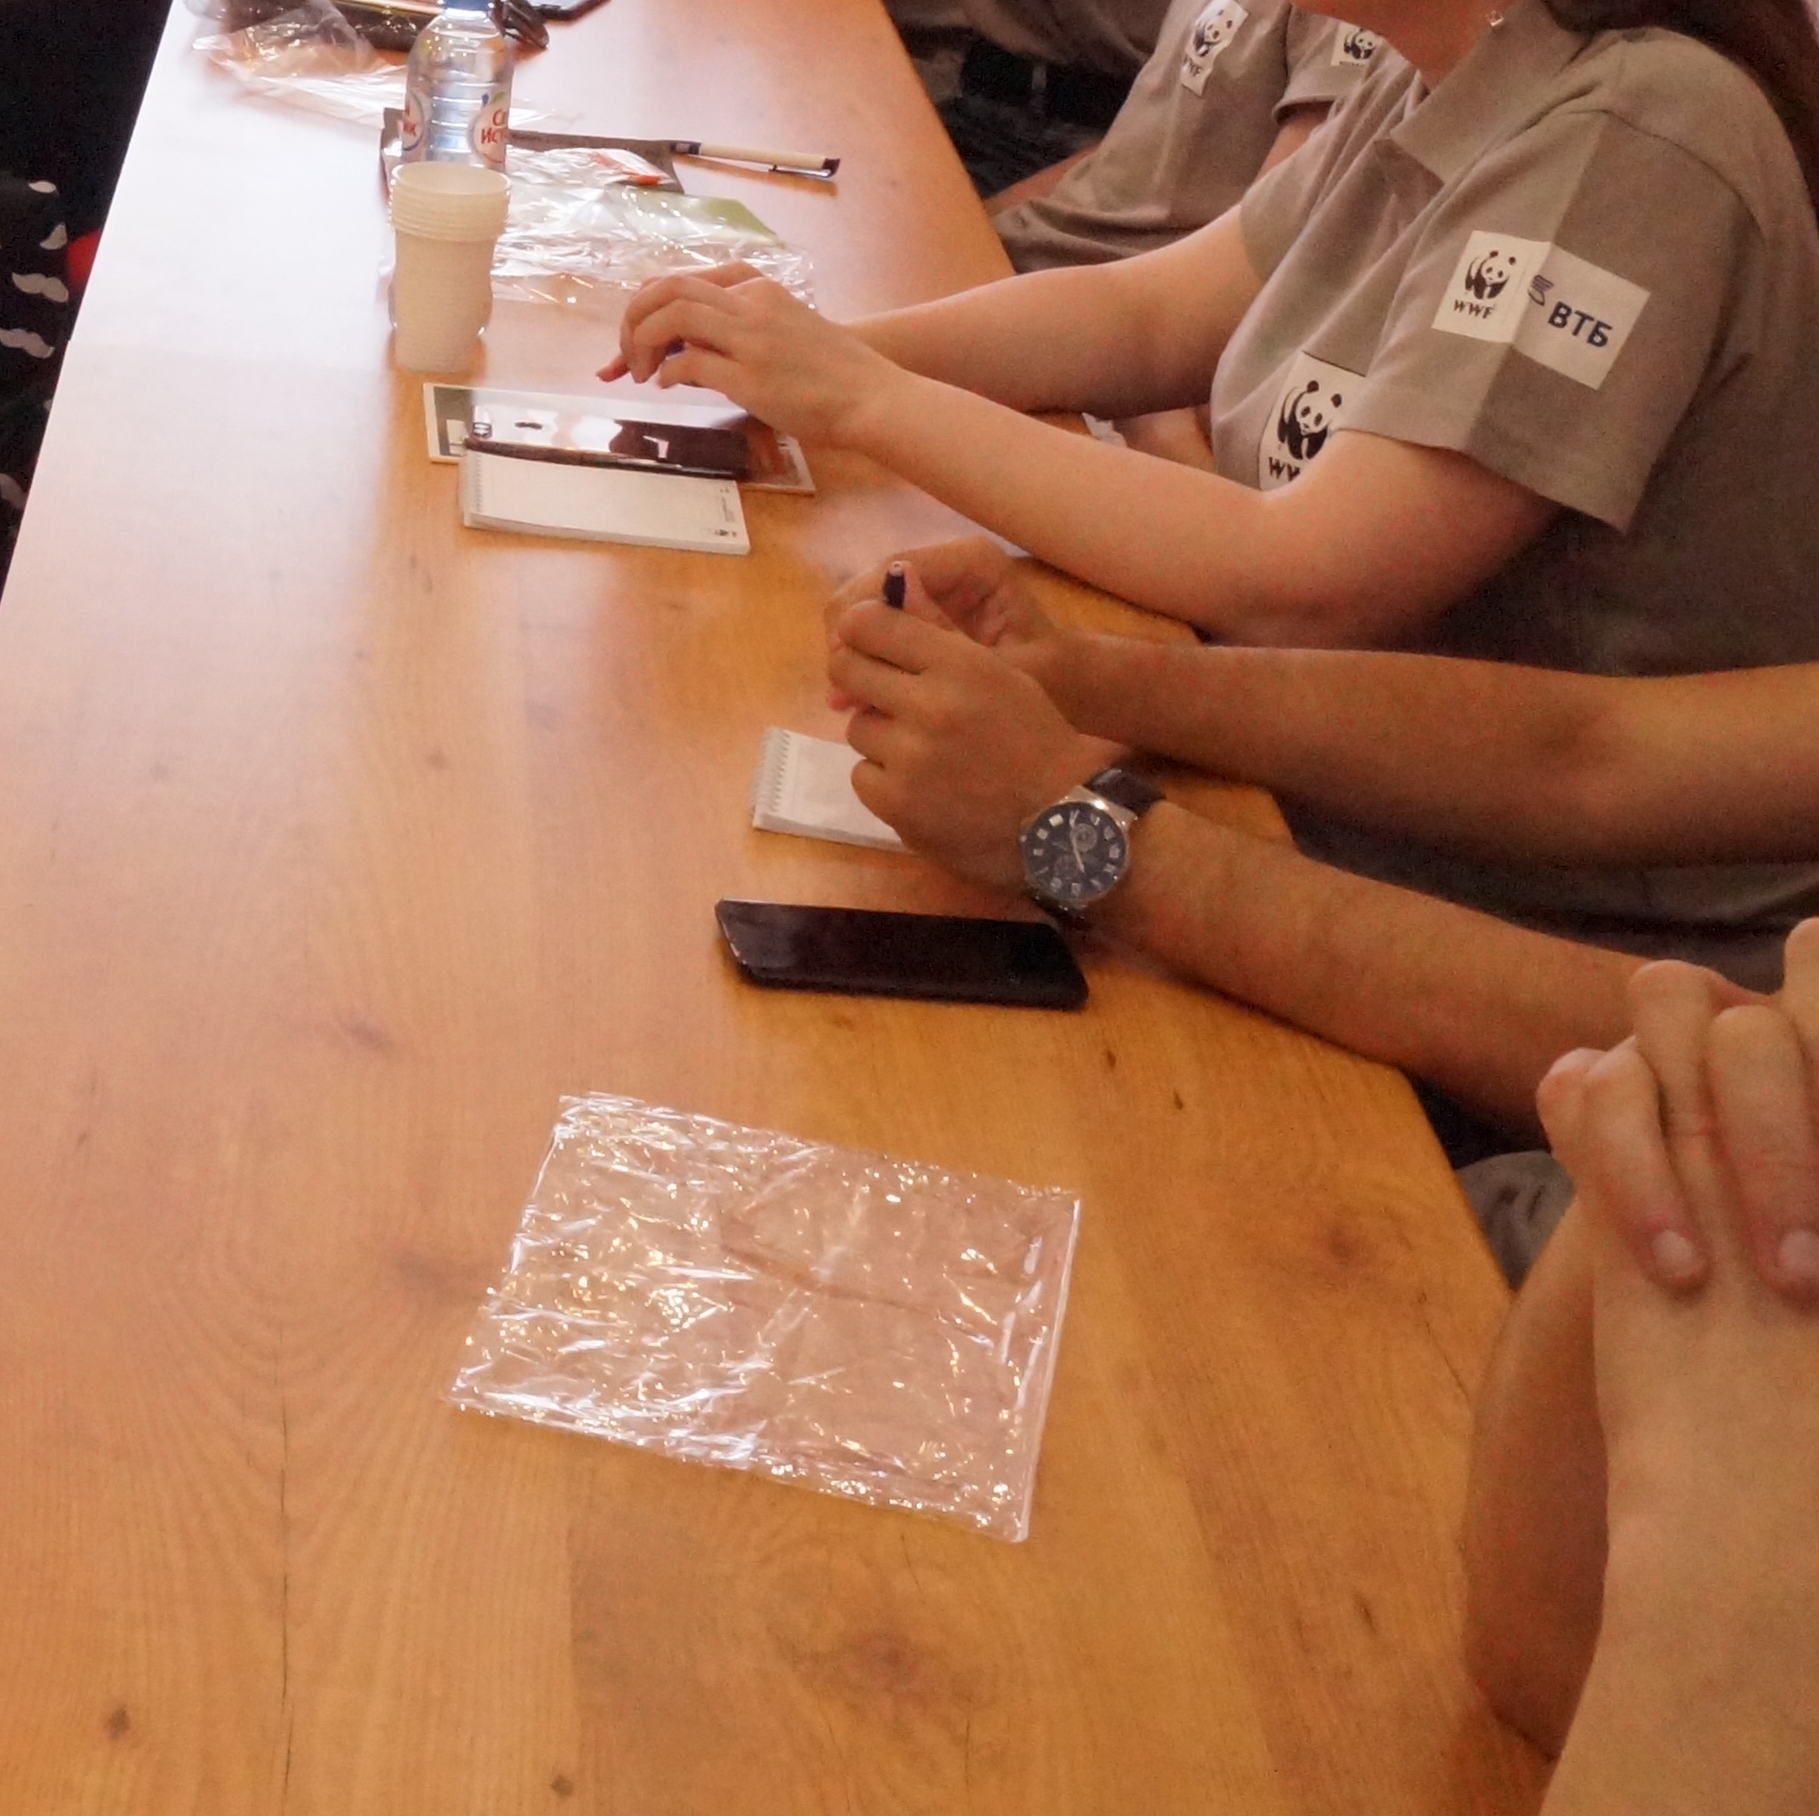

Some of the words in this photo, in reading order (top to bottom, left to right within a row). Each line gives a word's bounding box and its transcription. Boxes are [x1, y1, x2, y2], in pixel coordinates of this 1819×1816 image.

[1453, 299, 1494, 320] WWF
[1547, 301, 1613, 347] ВТБ
[1268, 456, 1301, 483] WW
